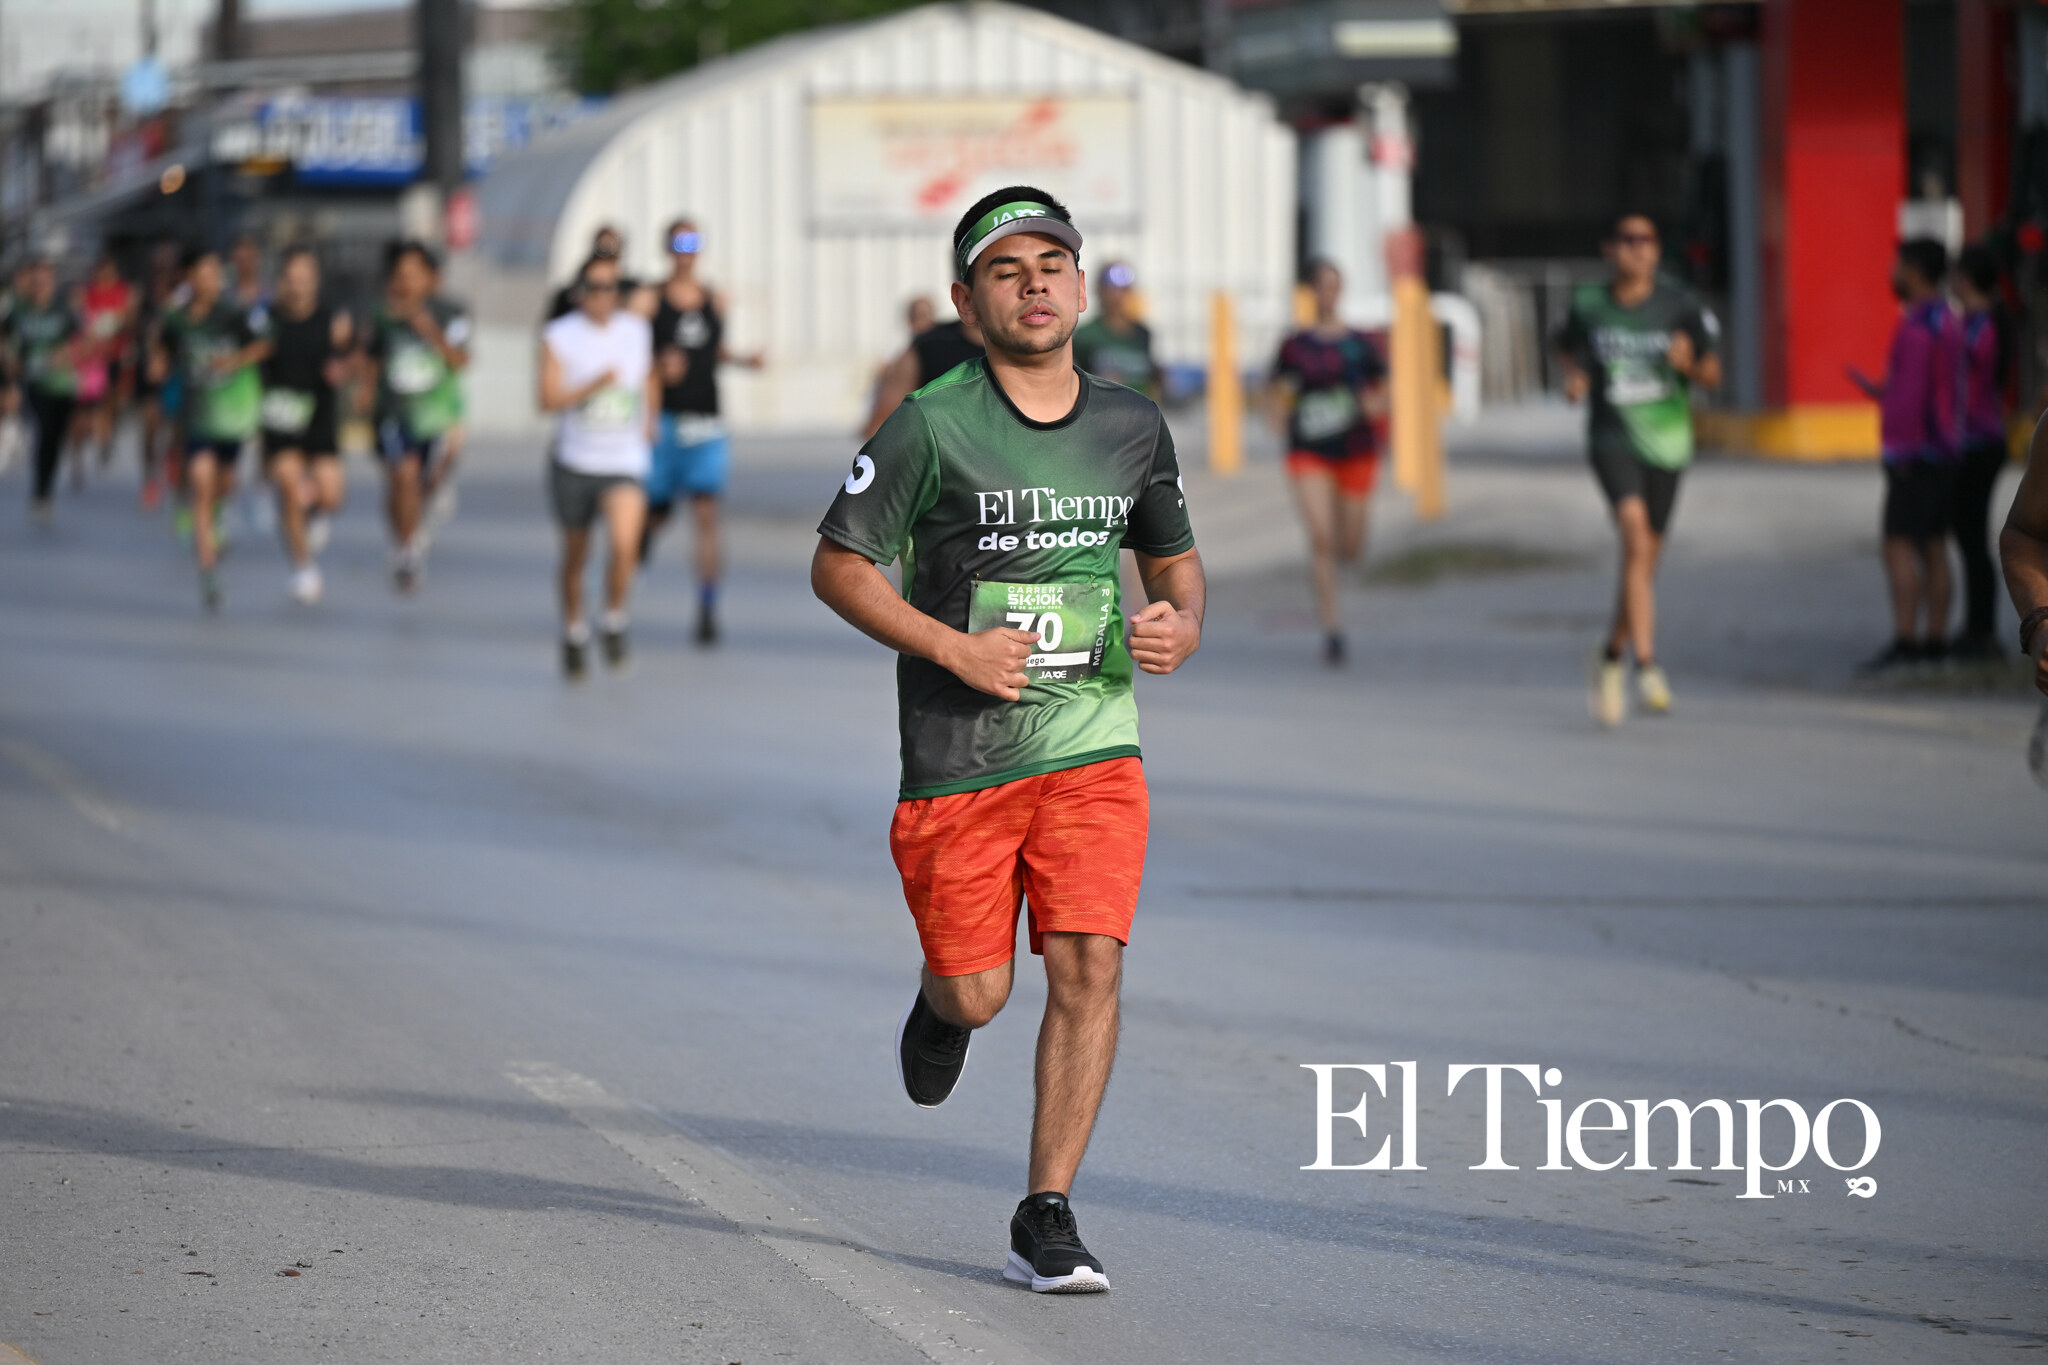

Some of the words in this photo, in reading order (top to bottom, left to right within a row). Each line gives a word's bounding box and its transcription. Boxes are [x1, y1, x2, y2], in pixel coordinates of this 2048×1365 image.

[974, 489, 1017, 526] El
[1021, 487, 1134, 528] Tiempo
[978, 532, 1020, 551] de
[1026, 527, 1110, 550] todos
[1008, 586, 1064, 594] CARRERA
[1101, 588, 1110, 597] 70
[1006, 612, 1063, 651] 70
[1092, 603, 1110, 666] MEDALLA
